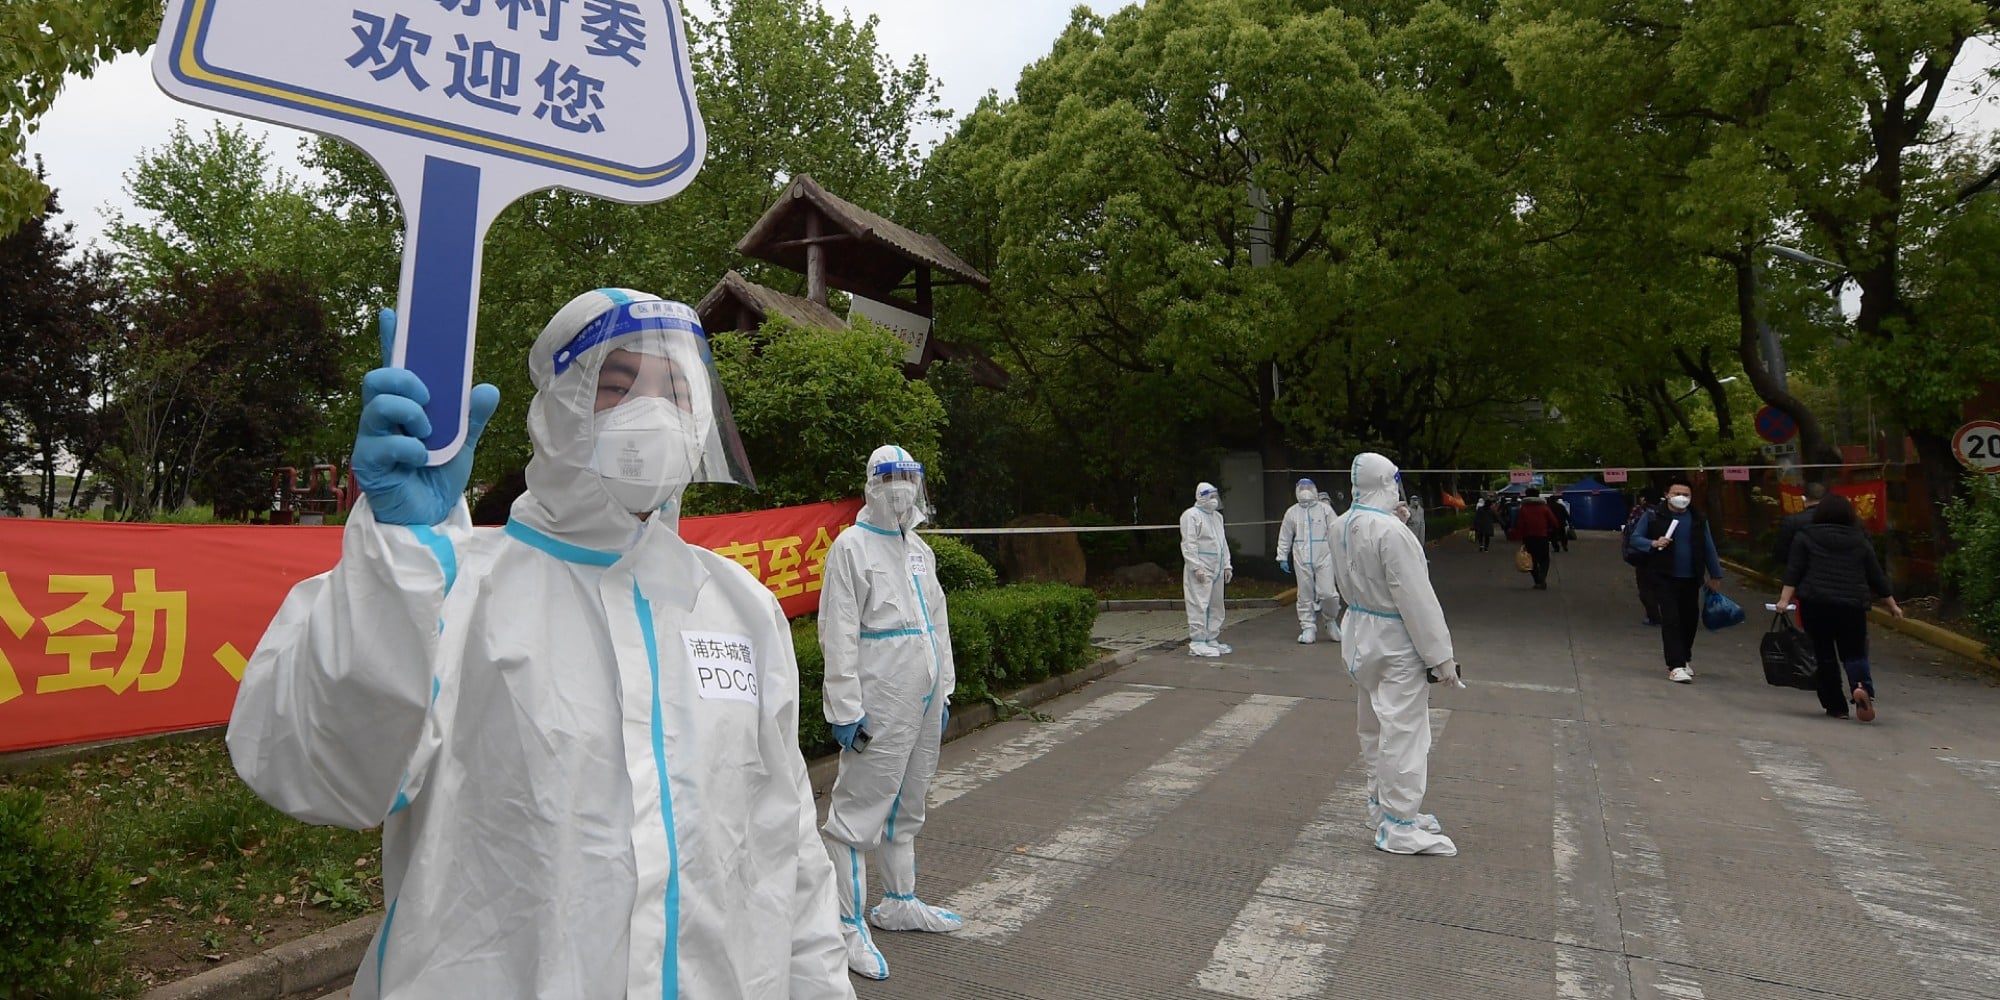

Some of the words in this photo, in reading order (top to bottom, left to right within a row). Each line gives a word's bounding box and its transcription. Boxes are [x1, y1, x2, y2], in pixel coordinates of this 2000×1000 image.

[439, 0, 646, 67] 村委
[344, 9, 605, 134] 欢迎您
[1967, 434, 2000, 459] 20
[689, 638, 752, 664] 浦东城管
[698, 667, 757, 696] PDCG
